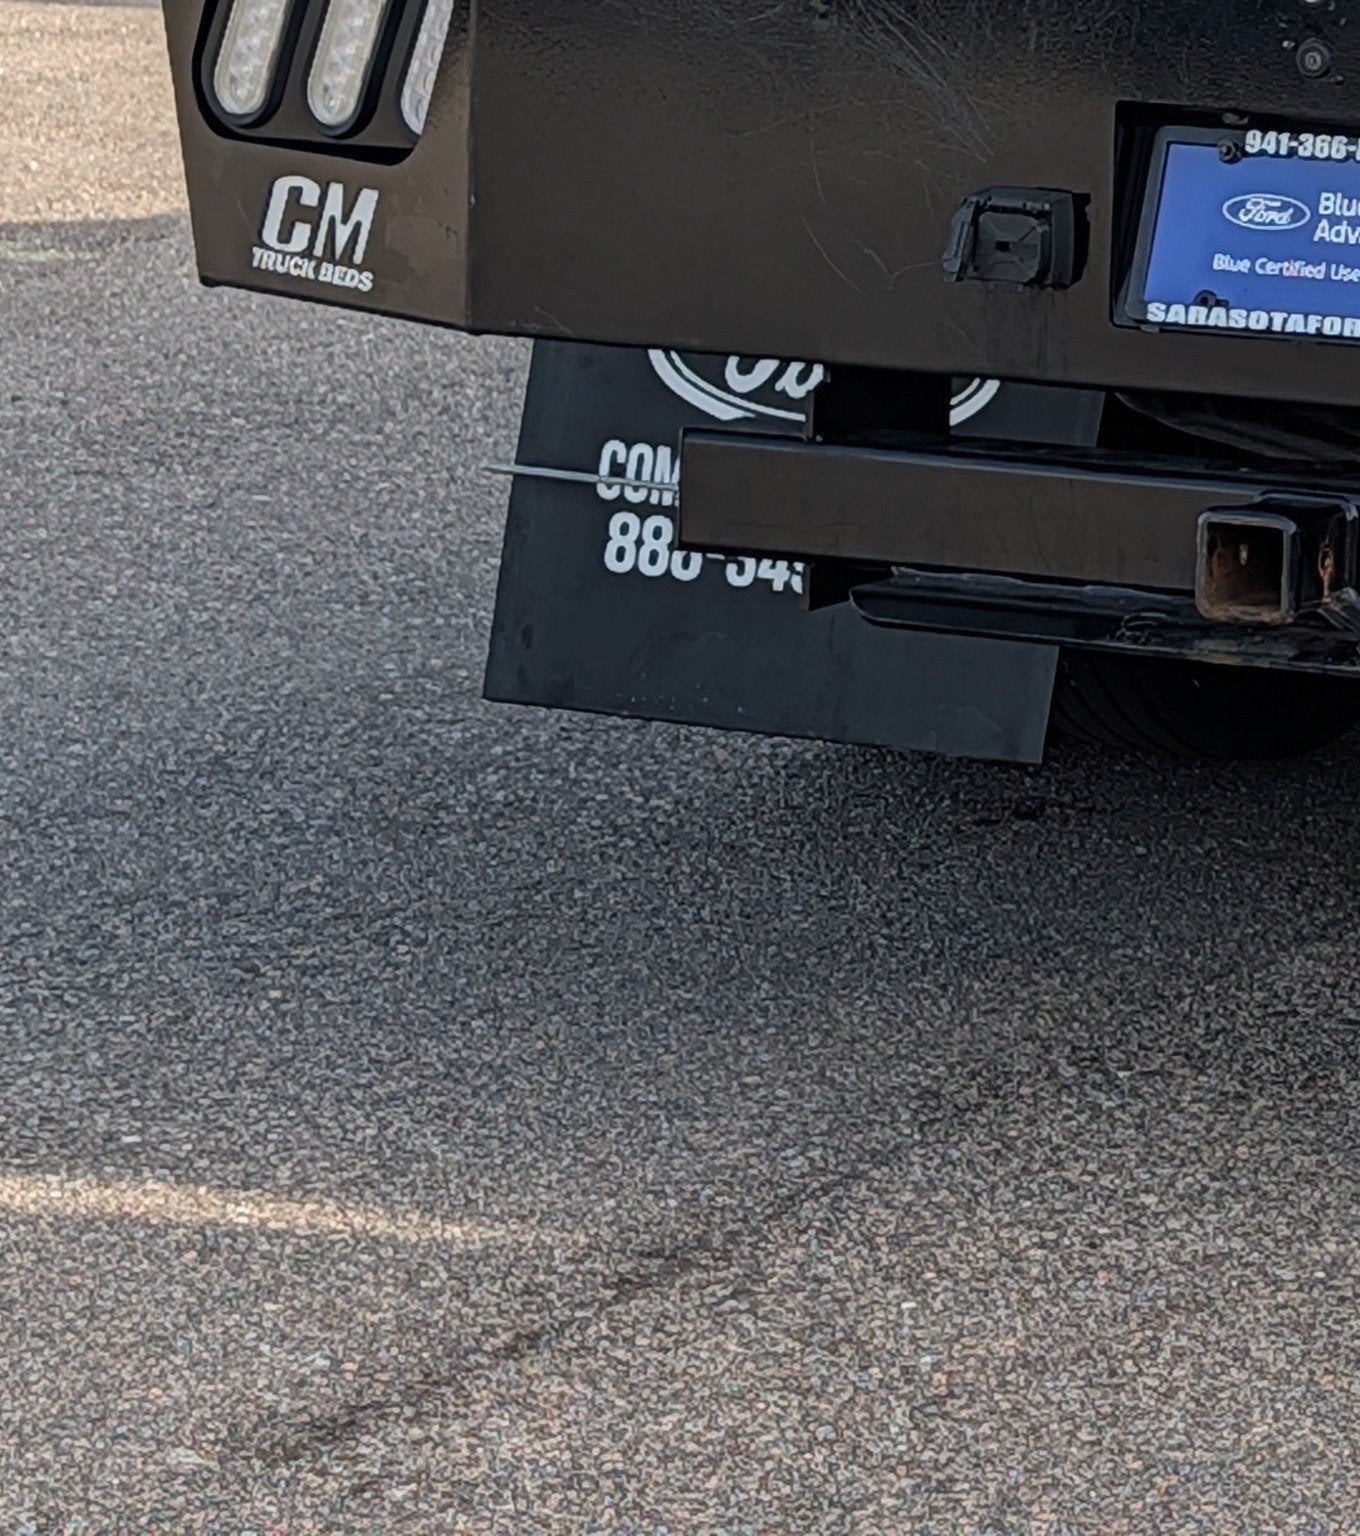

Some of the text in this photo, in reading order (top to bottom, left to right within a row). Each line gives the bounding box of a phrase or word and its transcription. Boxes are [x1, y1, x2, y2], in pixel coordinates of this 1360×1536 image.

[262, 175, 379, 264] CM
[1238, 197, 1295, 226] Ford
[251, 247, 375, 293] TRUCK BEDS
[1212, 253, 1251, 273] Blue
[1255, 257, 1325, 281] Certified
